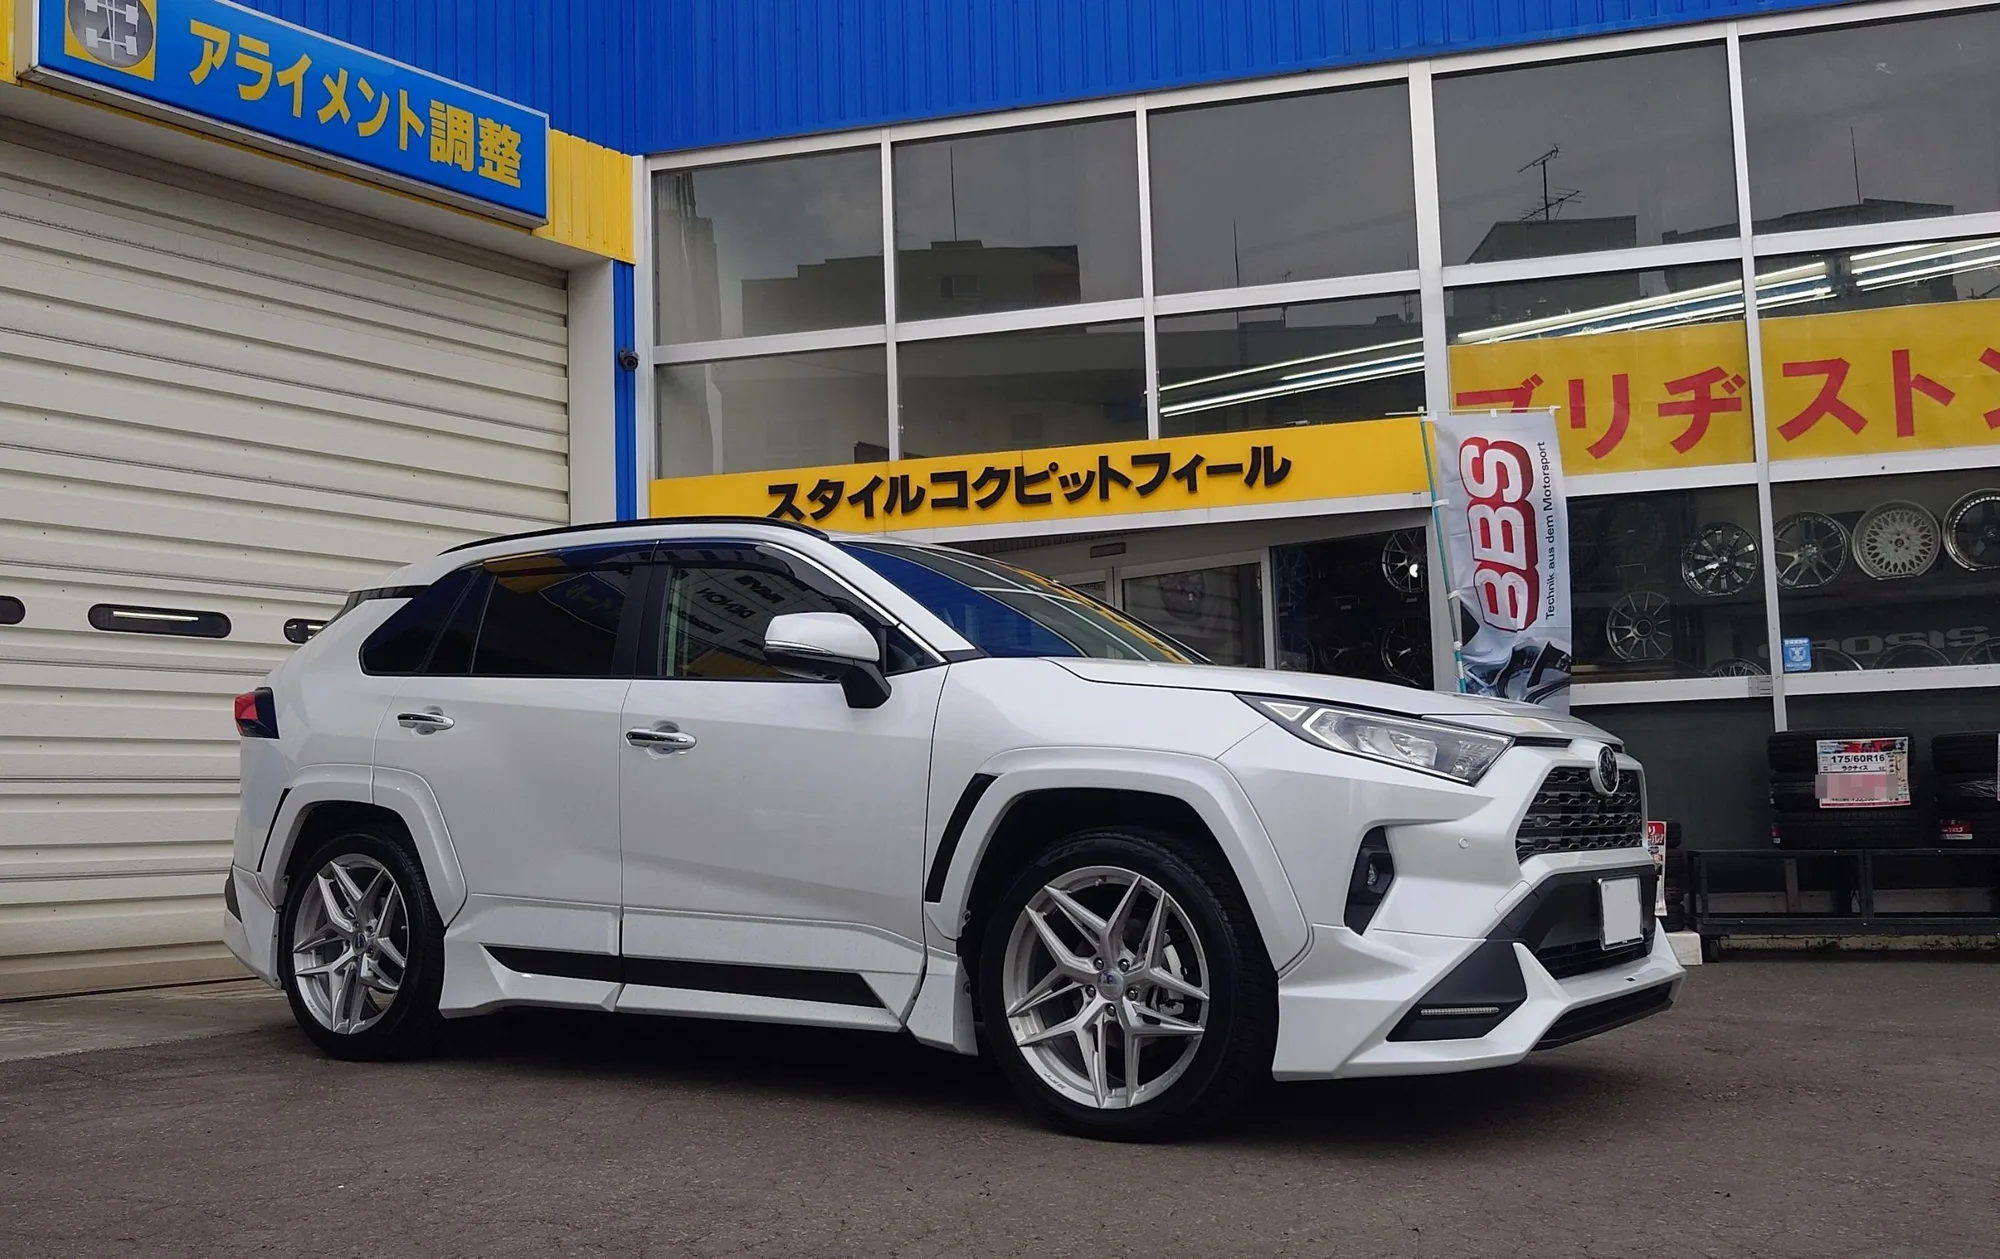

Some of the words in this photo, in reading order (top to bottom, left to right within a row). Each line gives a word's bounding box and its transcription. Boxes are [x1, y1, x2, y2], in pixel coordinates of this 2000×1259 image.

[188, 19, 523, 188] アライメント調整
[1456, 348, 2000, 460] ブリヂスト
[766, 446, 1292, 519] スタイルコクピットフィール
[1537, 441, 1554, 512] Motorsport
[1459, 436, 1539, 632] BBS
[1544, 514, 1556, 544] dem
[1547, 545, 1556, 570] aus
[1545, 572, 1556, 621] Technik
[1831, 754, 1885, 763] 175/60R16
